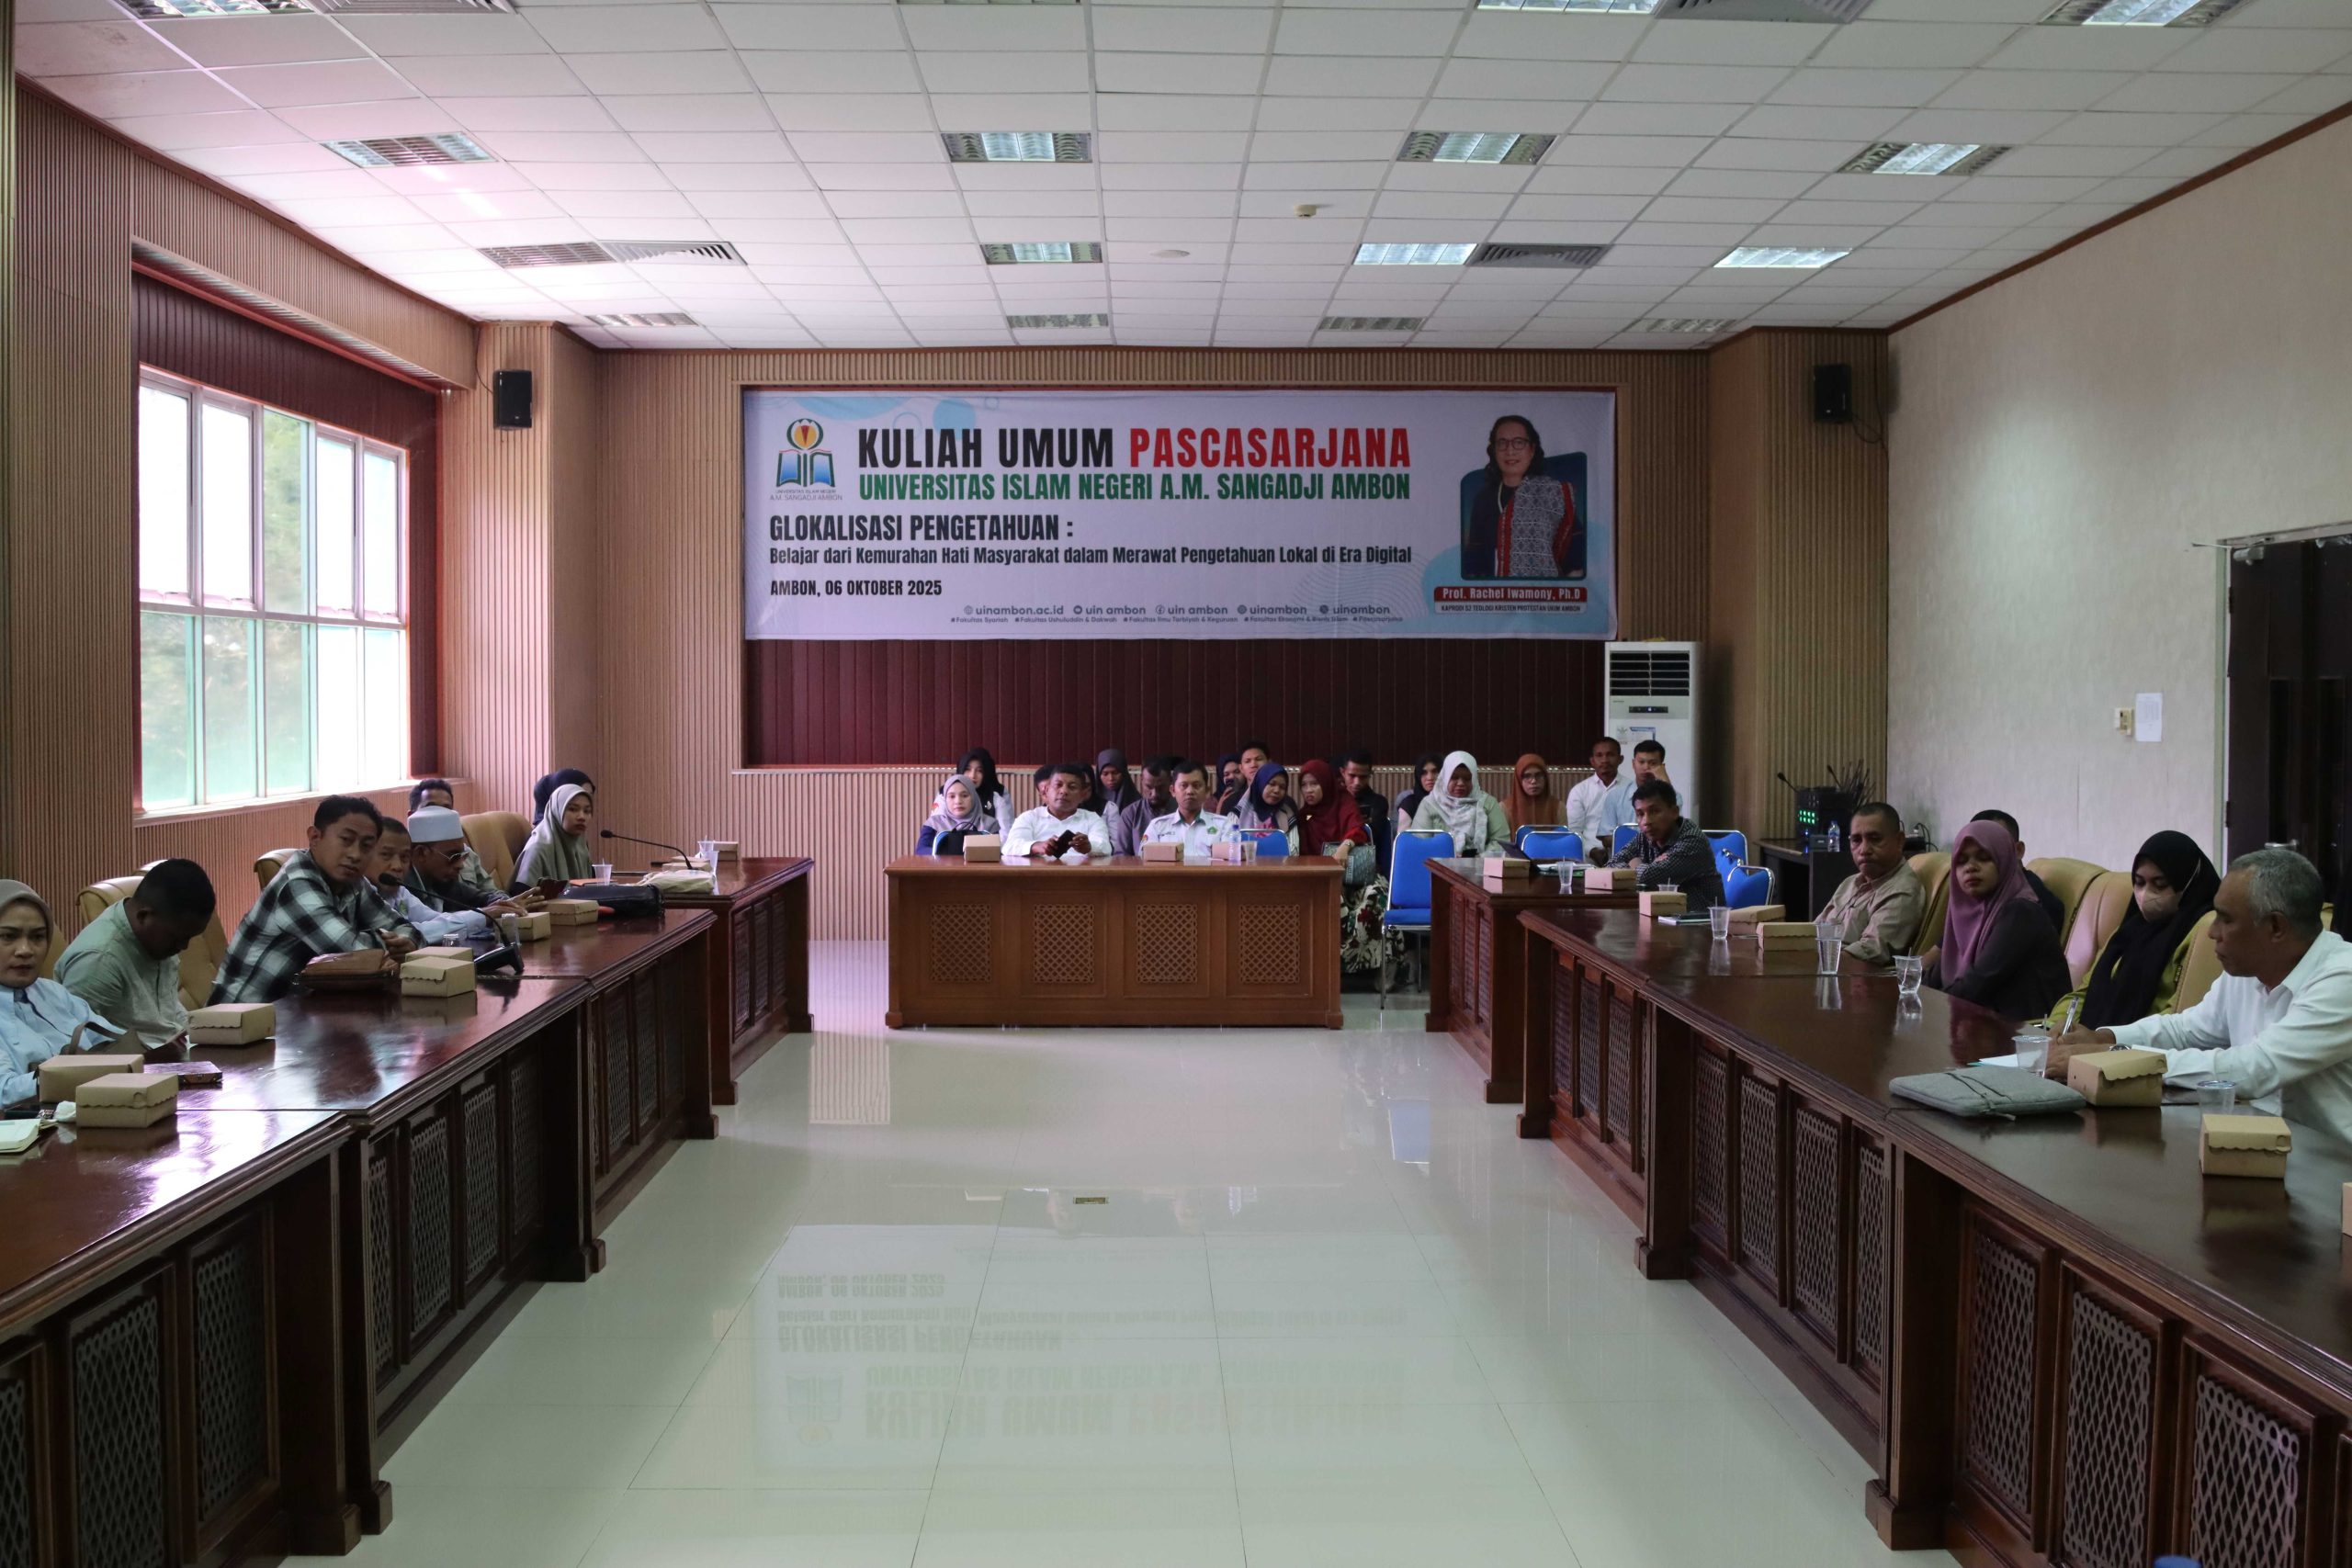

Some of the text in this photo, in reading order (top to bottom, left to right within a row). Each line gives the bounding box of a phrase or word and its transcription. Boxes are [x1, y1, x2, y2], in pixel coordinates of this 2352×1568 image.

[858, 428, 1410, 468] KULIAH UMUM PASCASARJANA
[859, 474, 1410, 501] UNIVERSITAS ISLAM NEGERI A.M. SANGADJI AMBON
[769, 514, 902, 542] GLOKALISASI
[910, 514, 1059, 541] PENGETAHUAN
[769, 546, 1412, 566] Belajar dari Kemurahan Hati Masyarakat dalam Merawat Pengetahuan Lokal di Era Digital
[770, 580, 943, 598] AMBON, 06 OKTOBER 2025
[1442, 588, 1580, 601] Prof. Rachel Iwamony, Ph.D
[975, 604, 1064, 615] uinambon.ac.id
[1085, 604, 1147, 615] uin ambon
[1167, 604, 1228, 615] uin ambon
[1250, 604, 1307, 615] uinambon
[1332, 604, 1391, 615] uinambon
